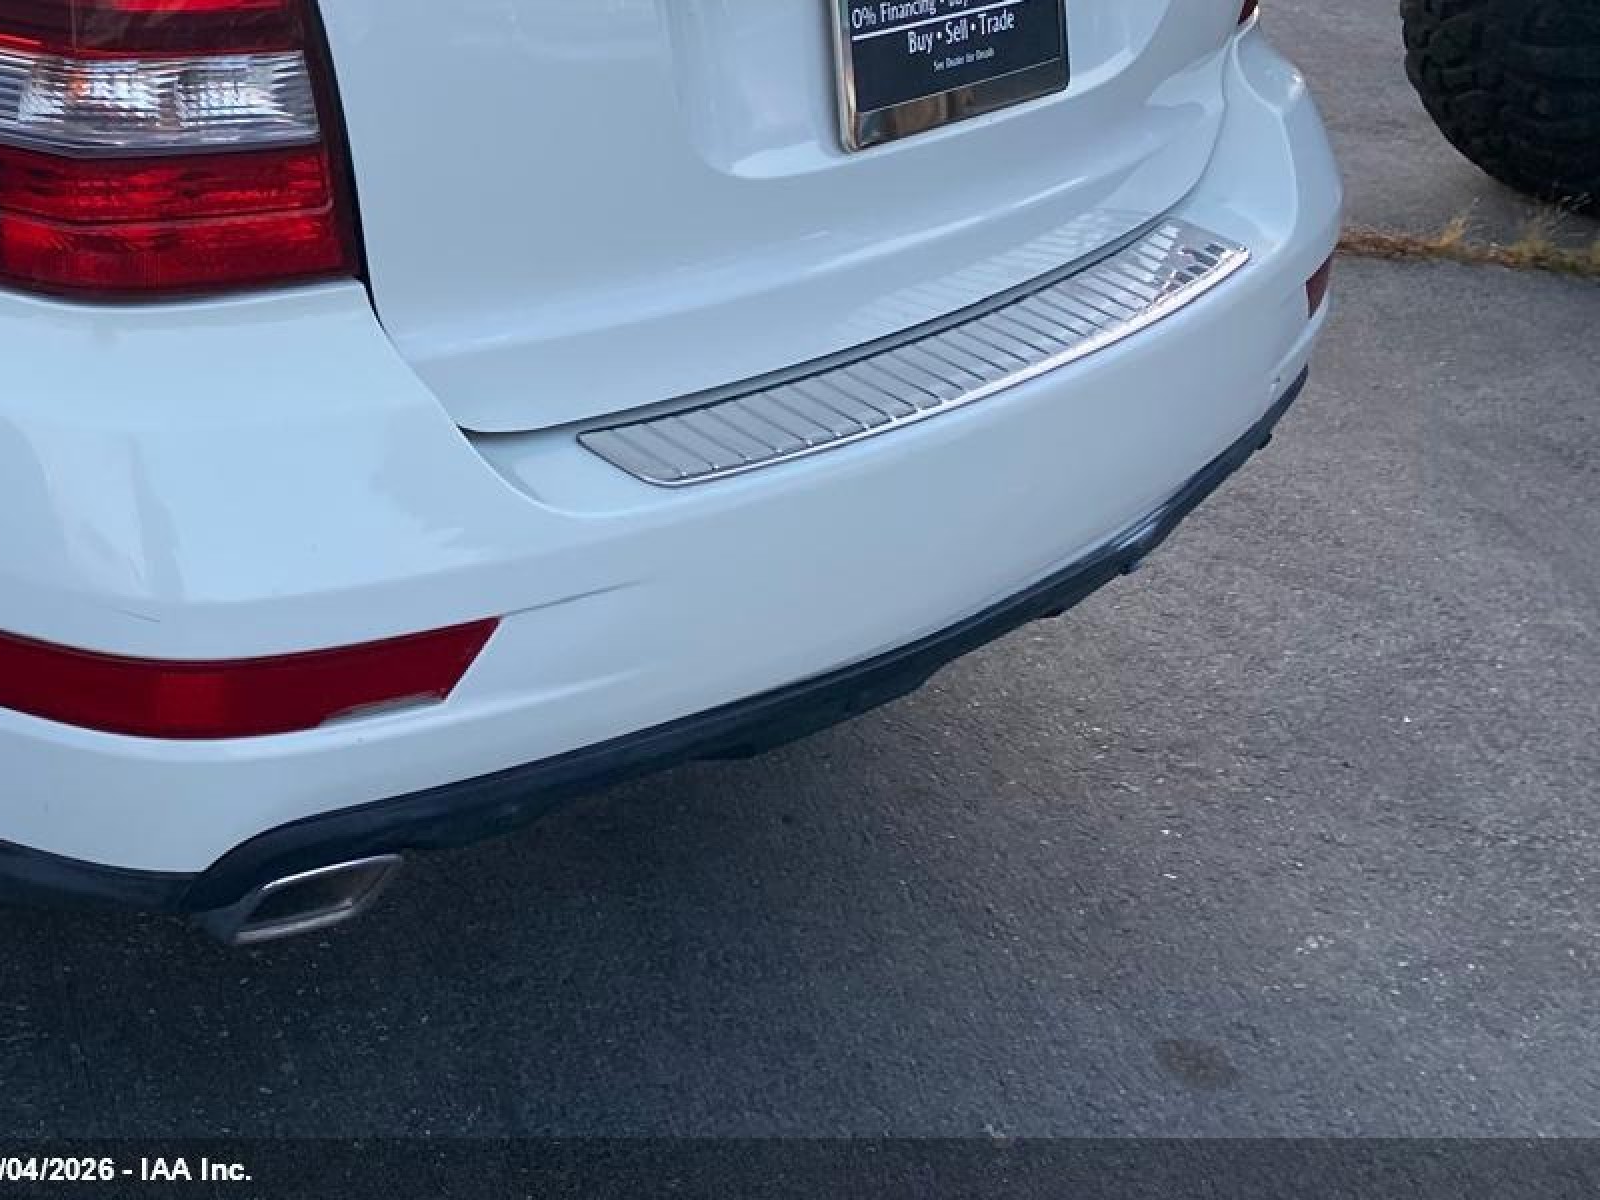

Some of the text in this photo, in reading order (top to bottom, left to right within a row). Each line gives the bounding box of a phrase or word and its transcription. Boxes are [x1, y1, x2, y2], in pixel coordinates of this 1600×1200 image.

[851, 5, 877, 29] 0%
[907, 30, 933, 54] Buy
[945, 17, 969, 45] Sell
[977, 7, 1015, 35] Trade
